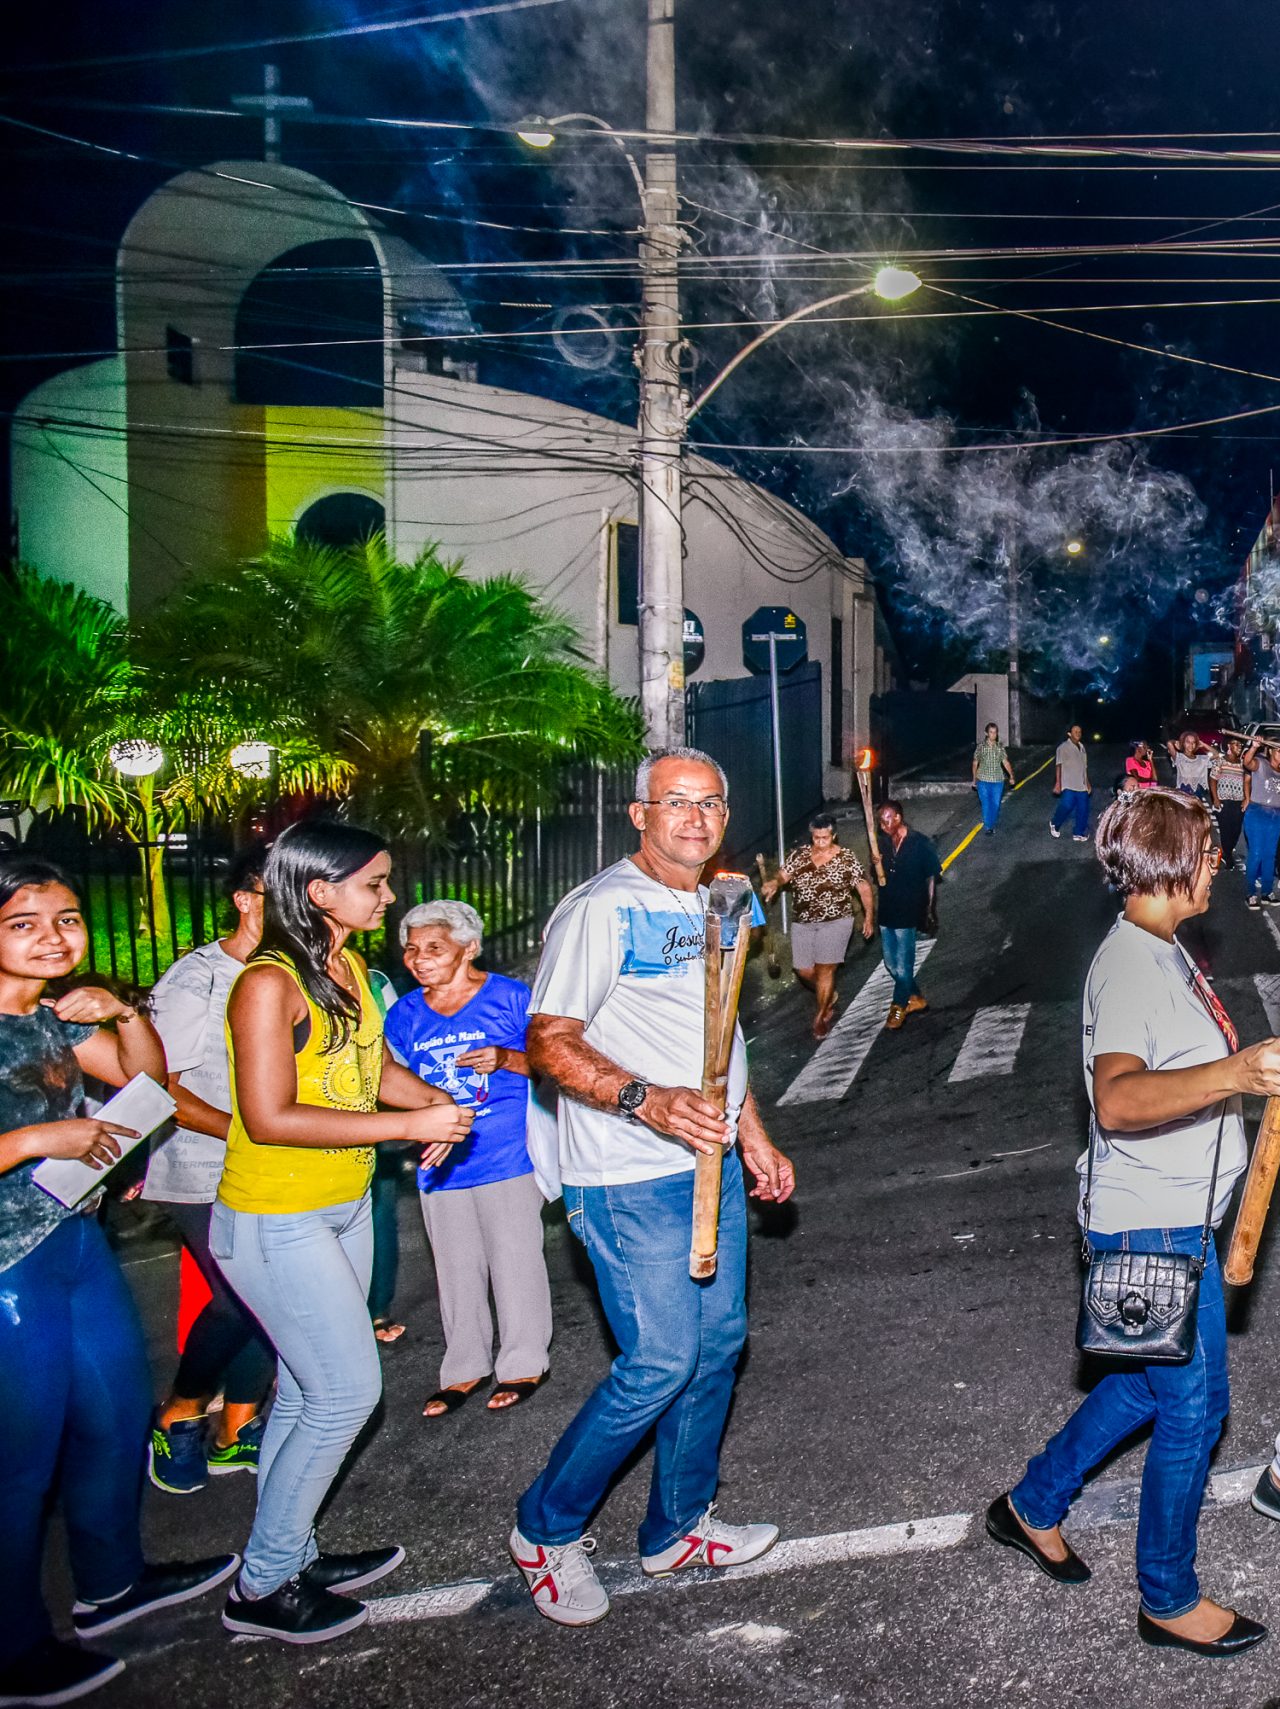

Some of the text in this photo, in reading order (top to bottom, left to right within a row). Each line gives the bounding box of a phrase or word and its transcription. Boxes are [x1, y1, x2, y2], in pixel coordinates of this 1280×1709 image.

[664, 955, 672, 965] O
[413, 1030, 485, 1052] Legião de Maria
